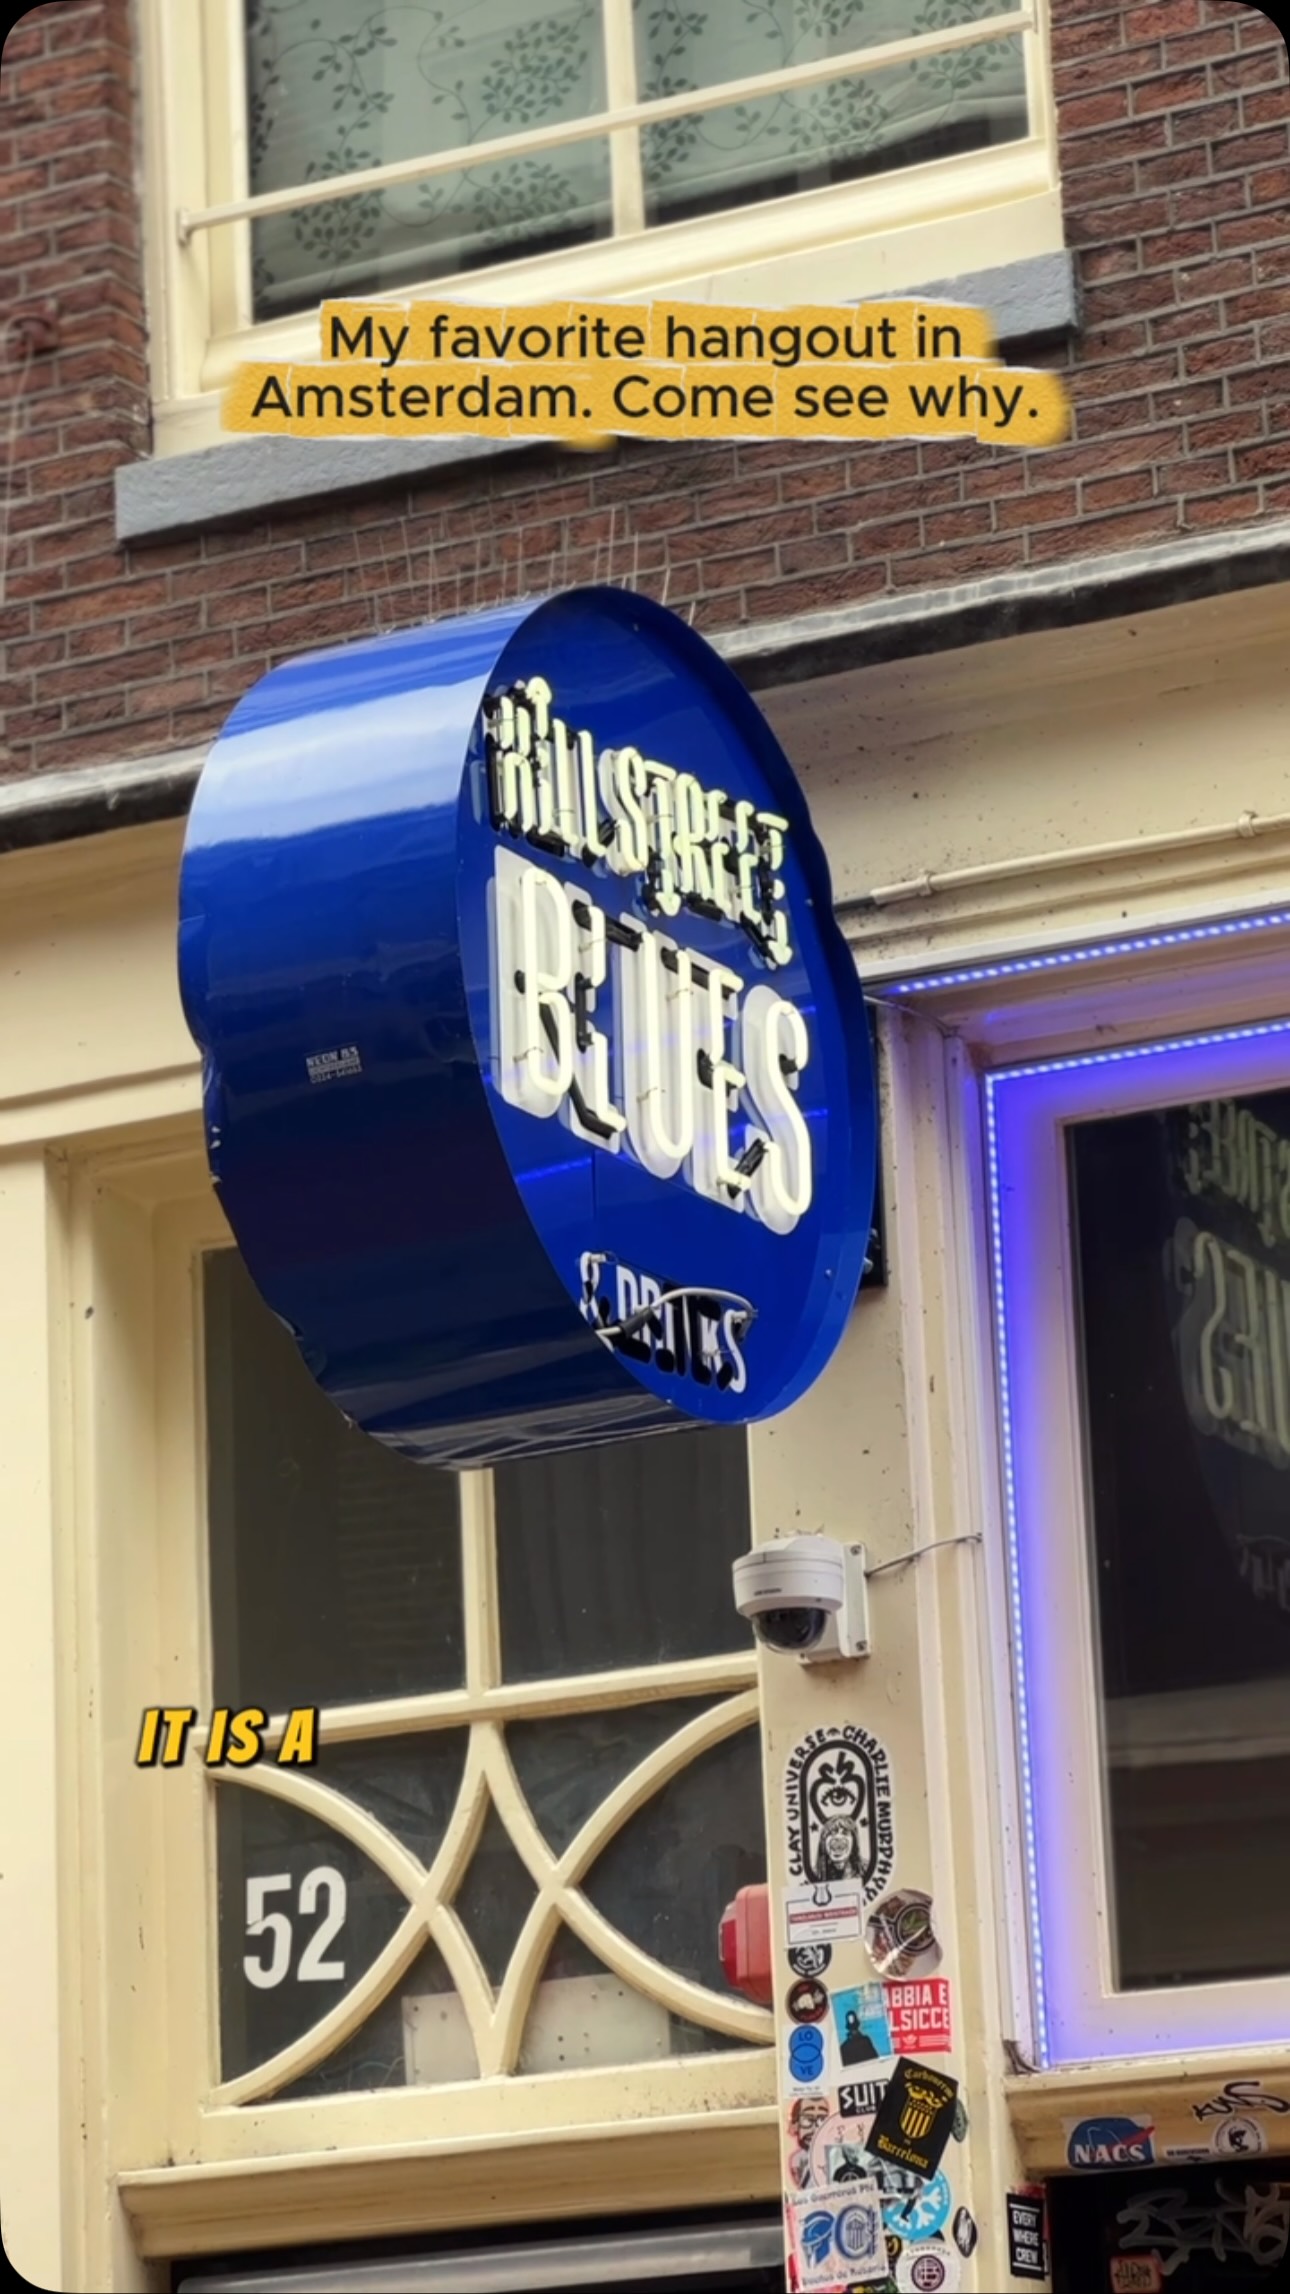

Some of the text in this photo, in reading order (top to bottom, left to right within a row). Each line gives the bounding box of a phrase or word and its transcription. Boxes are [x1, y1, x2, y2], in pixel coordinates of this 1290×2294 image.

[494, 848, 812, 1234] BLUES
[842, 1725, 890, 1796] CHARLIE
[786, 1728, 827, 1820] UNIVERSE
[787, 1826, 803, 1876] CLAY
[244, 1866, 346, 1989] 52
[939, 1983, 948, 2005] E
[798, 2031, 813, 2042] LO
[800, 2066, 814, 2077] VE
[841, 2081, 888, 2109] SUIT
[1075, 2145, 1146, 2164] NACS
[1013, 2210, 1036, 2228] EVERY
[1013, 2228, 1038, 2247] WHERE
[1016, 2247, 1038, 2264] CREW
